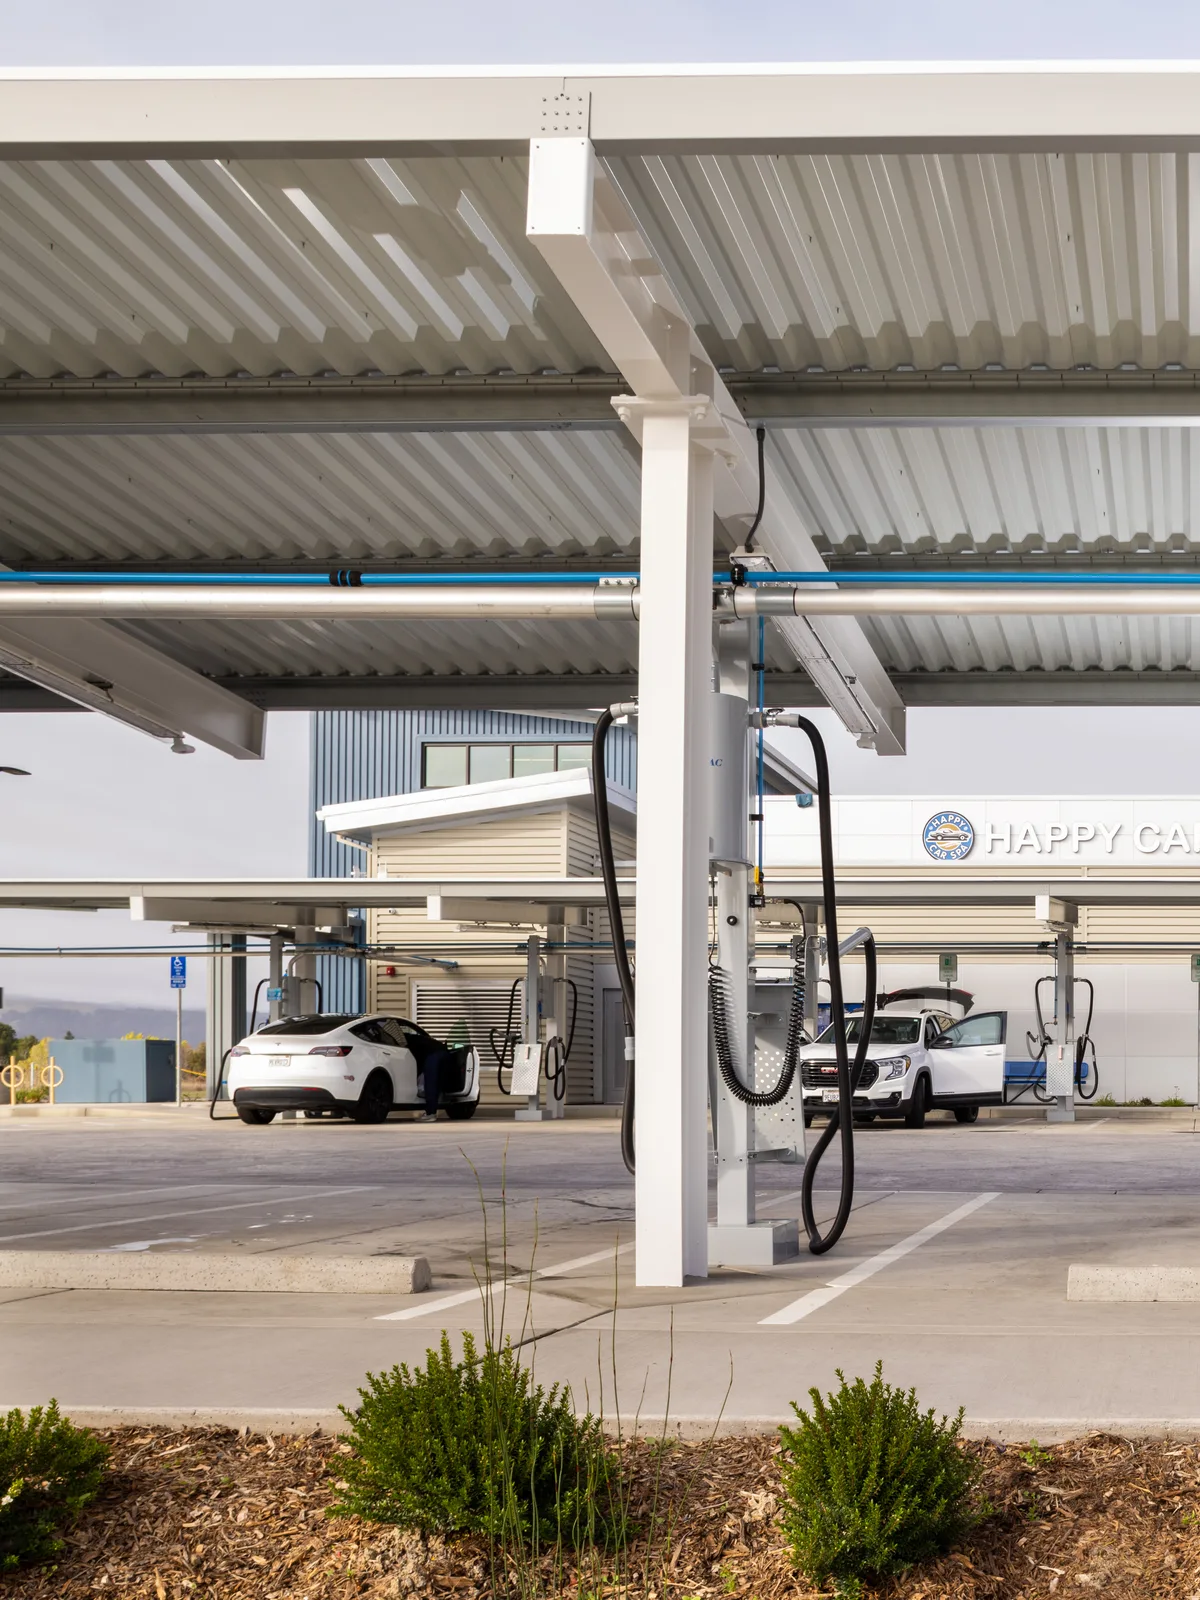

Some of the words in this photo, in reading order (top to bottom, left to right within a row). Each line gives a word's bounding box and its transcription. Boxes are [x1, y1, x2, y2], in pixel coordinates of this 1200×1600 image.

[930, 815, 966, 828] HAPPY
[985, 822, 1123, 854] HAPPY
[929, 844, 947, 859] CAR
[950, 845, 968, 859] SPA
